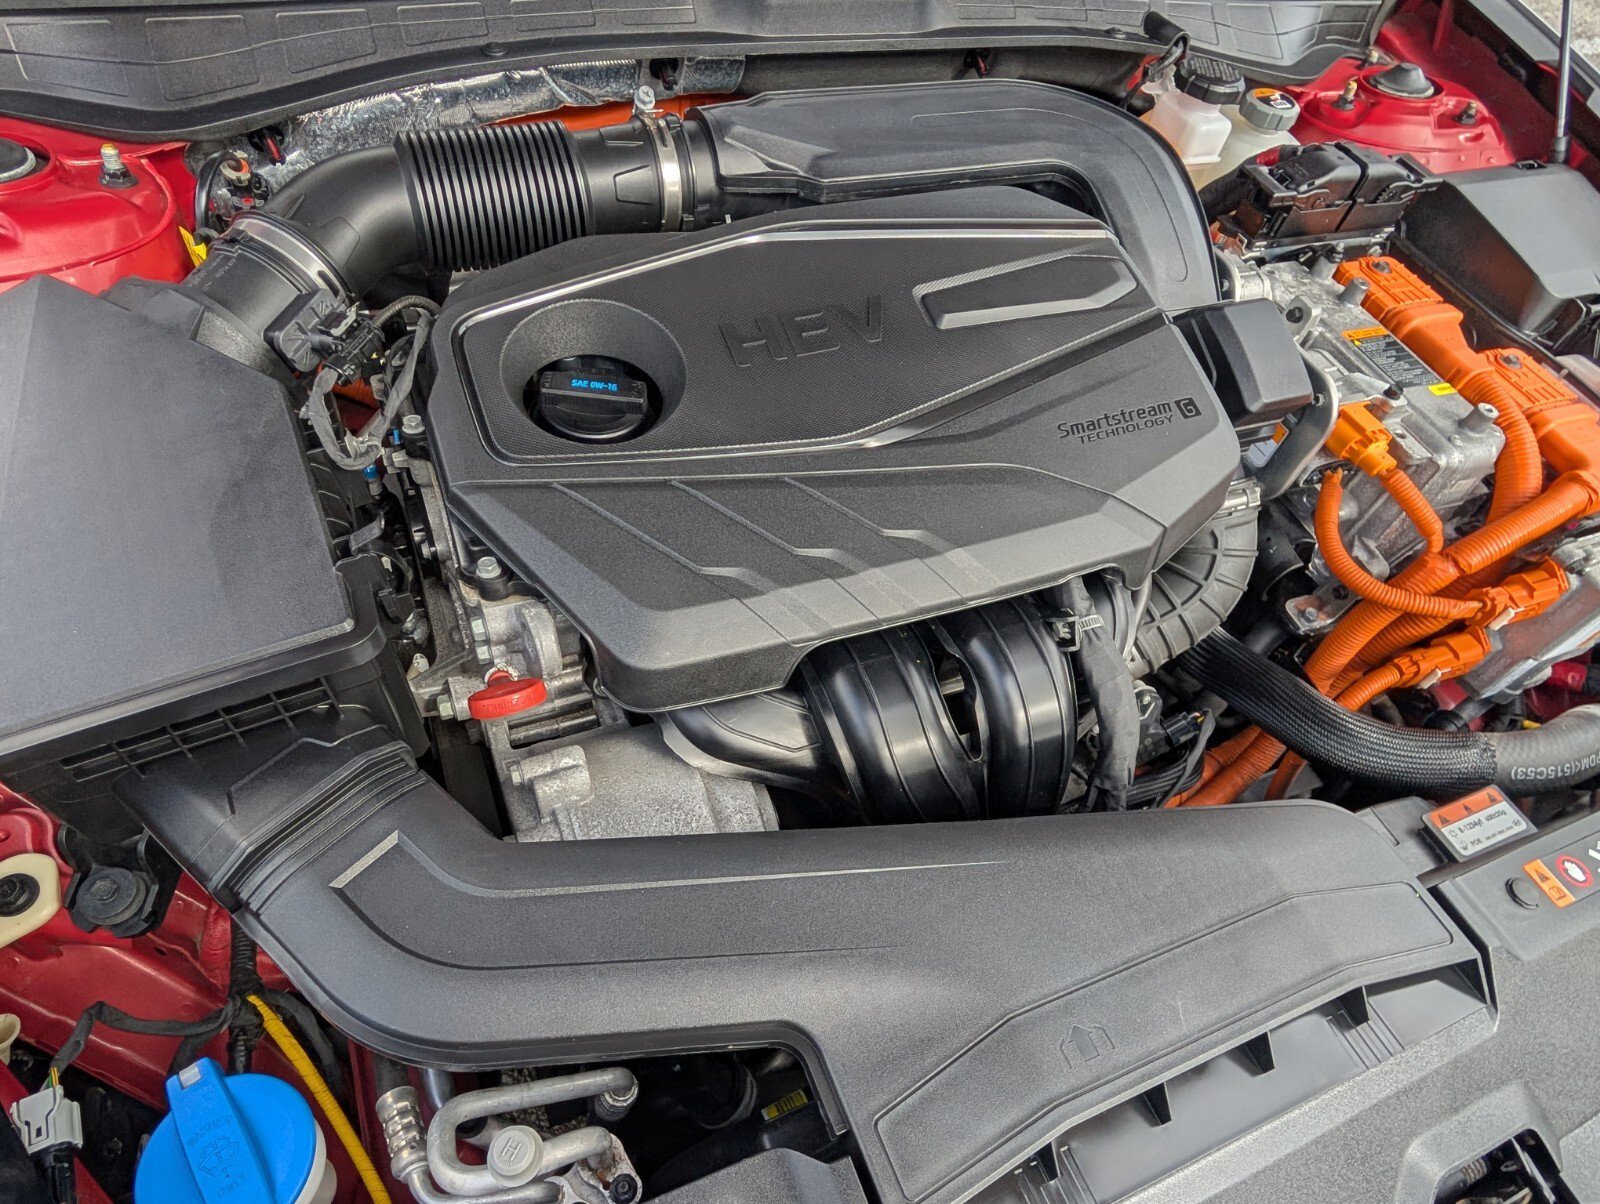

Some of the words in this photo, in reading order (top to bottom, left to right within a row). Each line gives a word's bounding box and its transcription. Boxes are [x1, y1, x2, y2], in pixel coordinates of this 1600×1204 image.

[718, 294, 883, 368] HEV
[571, 379, 588, 388] SAE
[590, 381, 617, 391] 0W-16
[1057, 402, 1173, 438] Smartstream
[1077, 415, 1173, 444] TECHNOLOGY
[501, 1136, 523, 1162] H
